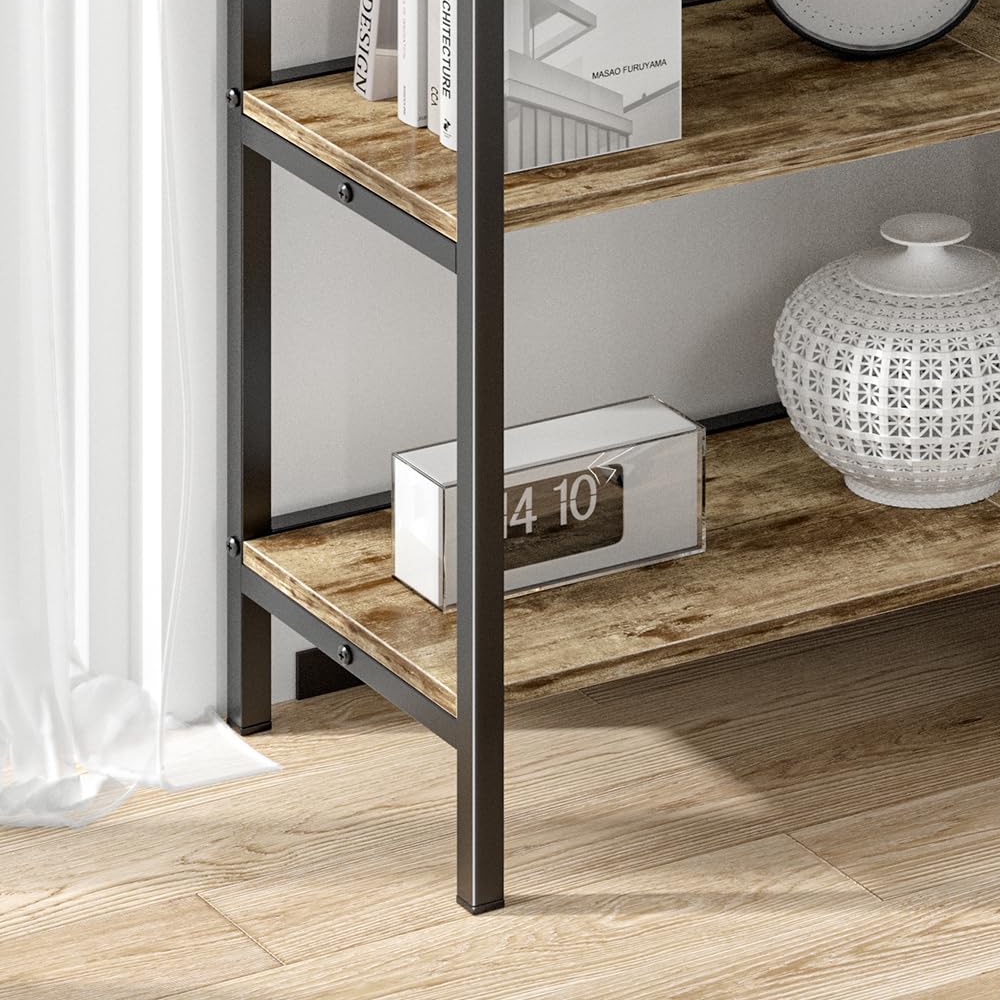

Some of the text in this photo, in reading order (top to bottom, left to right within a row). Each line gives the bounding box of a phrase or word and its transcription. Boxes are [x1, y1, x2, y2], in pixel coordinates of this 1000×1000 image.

[592, 58, 668, 80] MASAO FURUYAMA
[430, 86, 439, 107] CCA
[553, 473, 598, 527] 10
